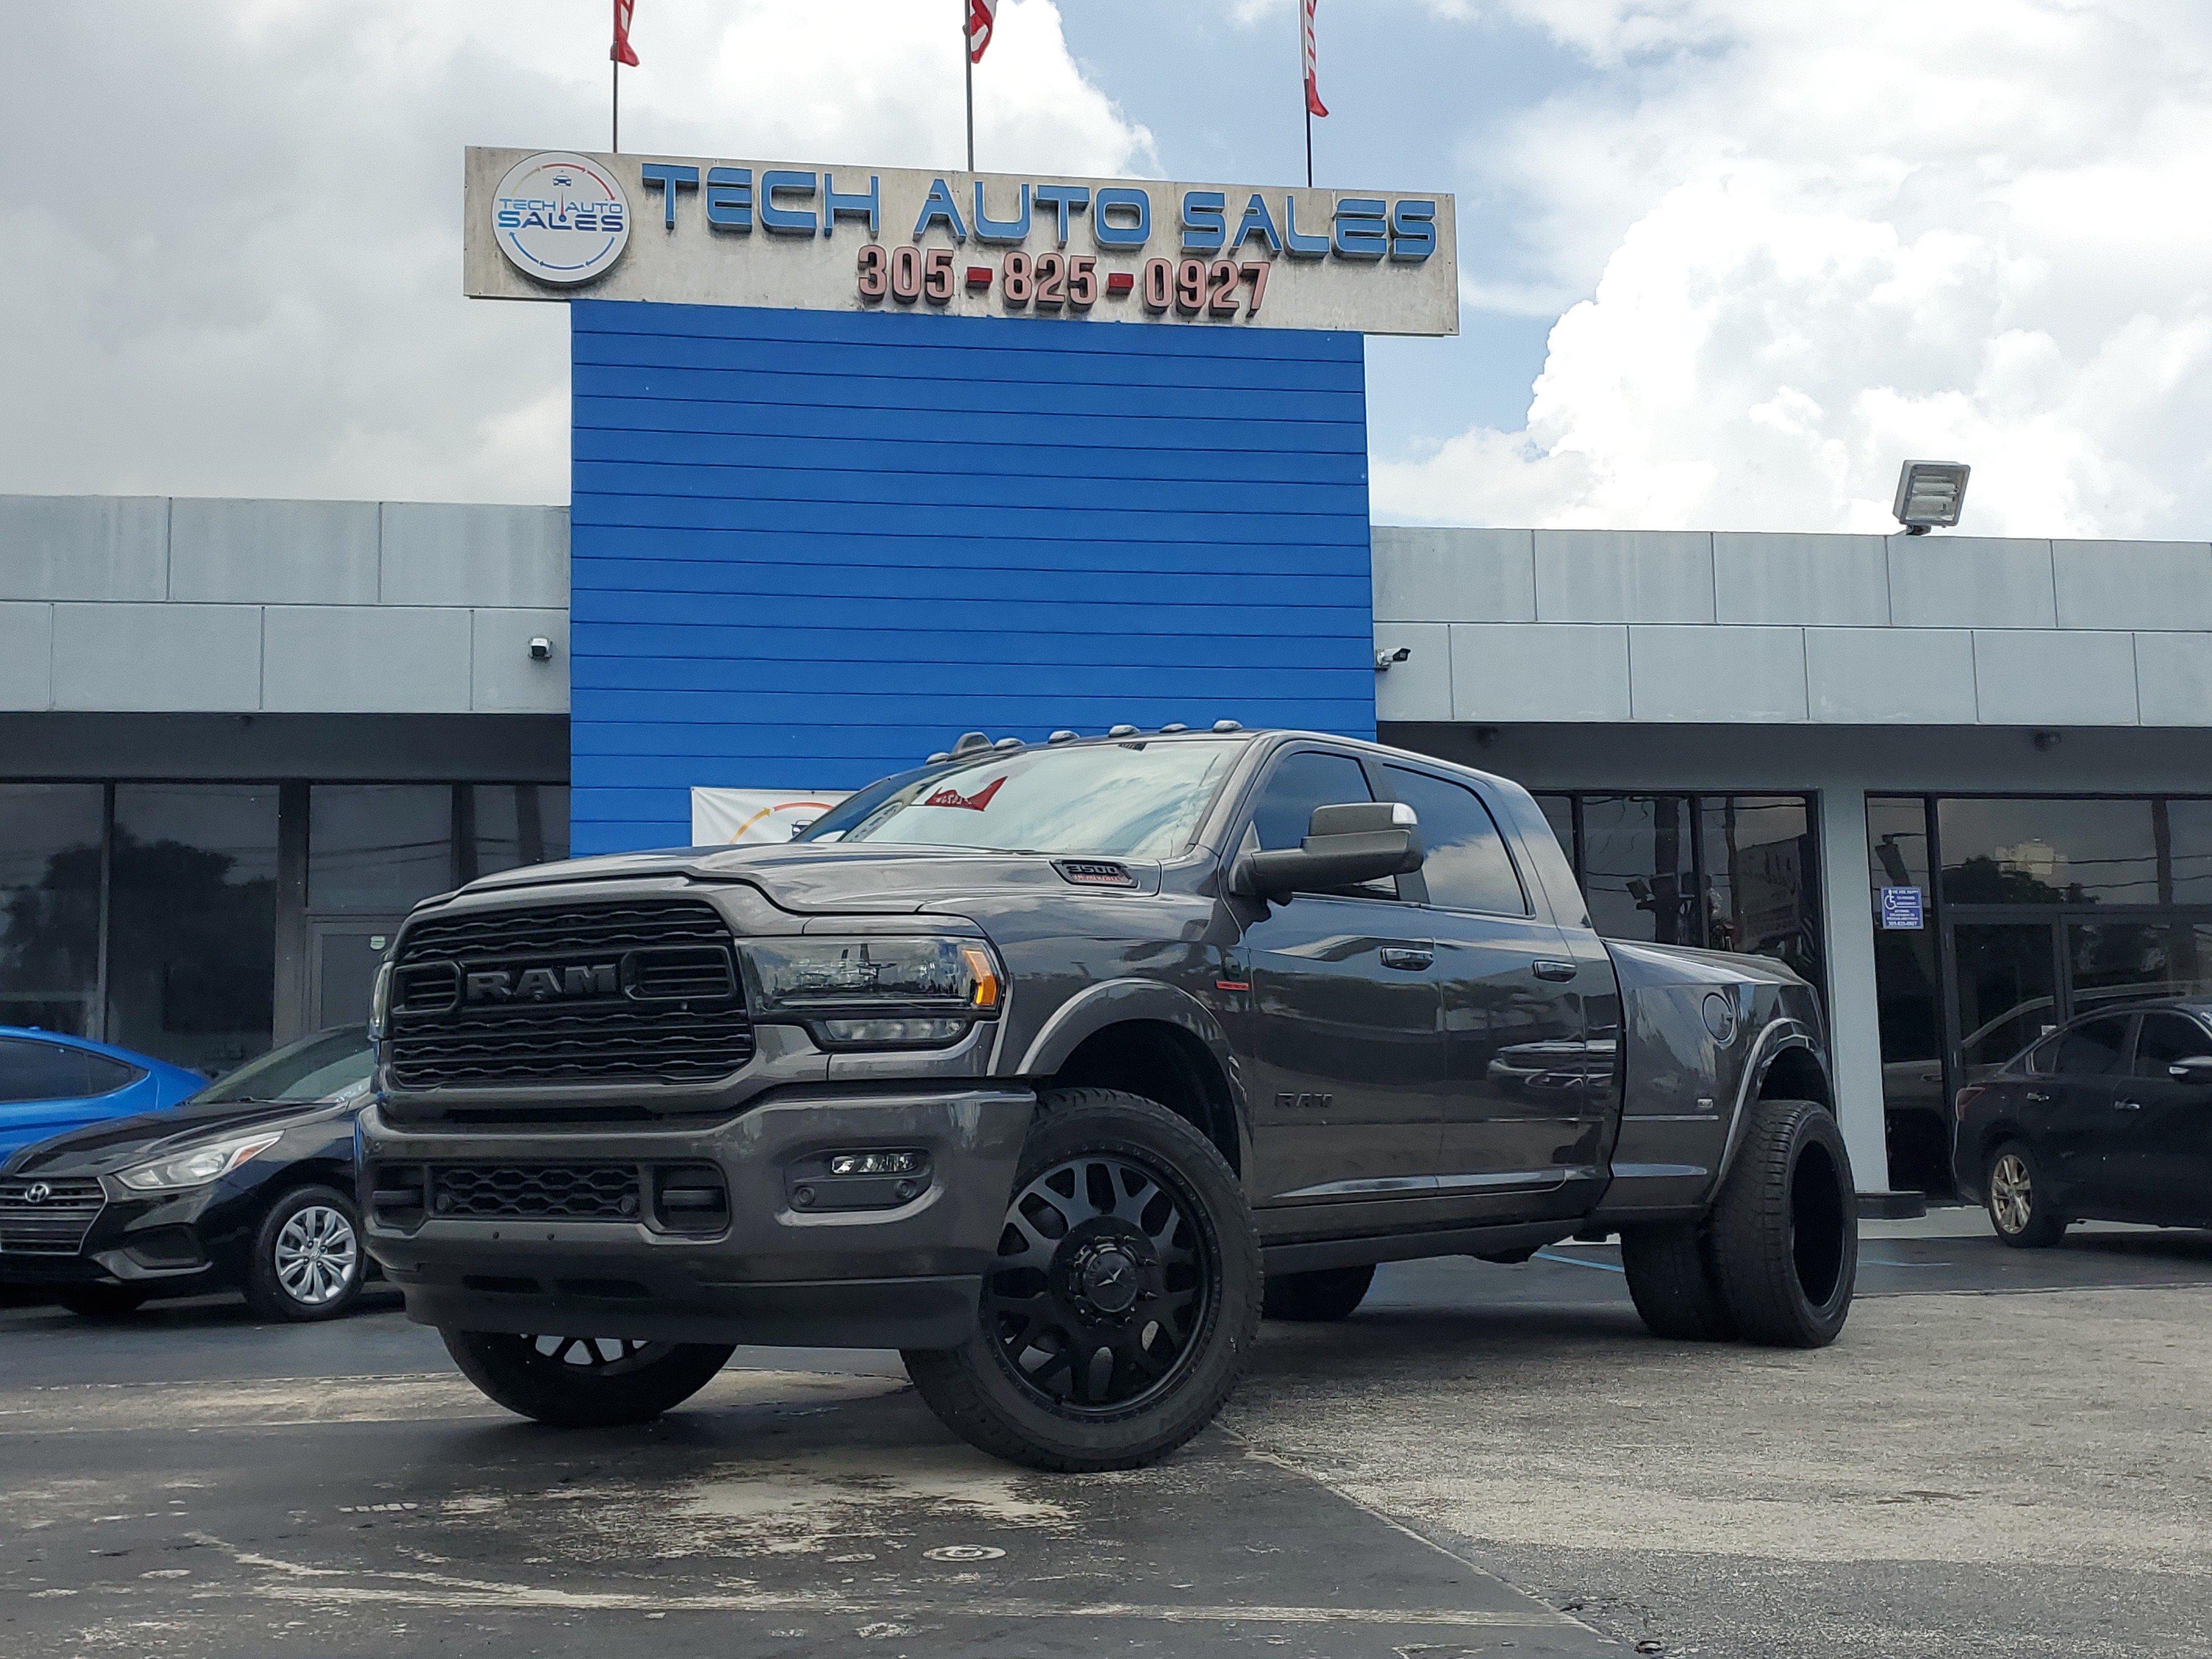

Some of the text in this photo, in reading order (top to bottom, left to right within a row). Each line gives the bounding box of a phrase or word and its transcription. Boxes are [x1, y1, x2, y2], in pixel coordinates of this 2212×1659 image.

[499, 198, 623, 213] TECH AUTO
[642, 163, 1437, 257] TECH AUTO SALES
[498, 211, 623, 232] SALES
[857, 245, 1271, 312] 305-825-0927
[1067, 865, 1118, 874] 3500
[467, 964, 616, 1000] RAM
[1274, 1093, 1333, 1107] RAM
